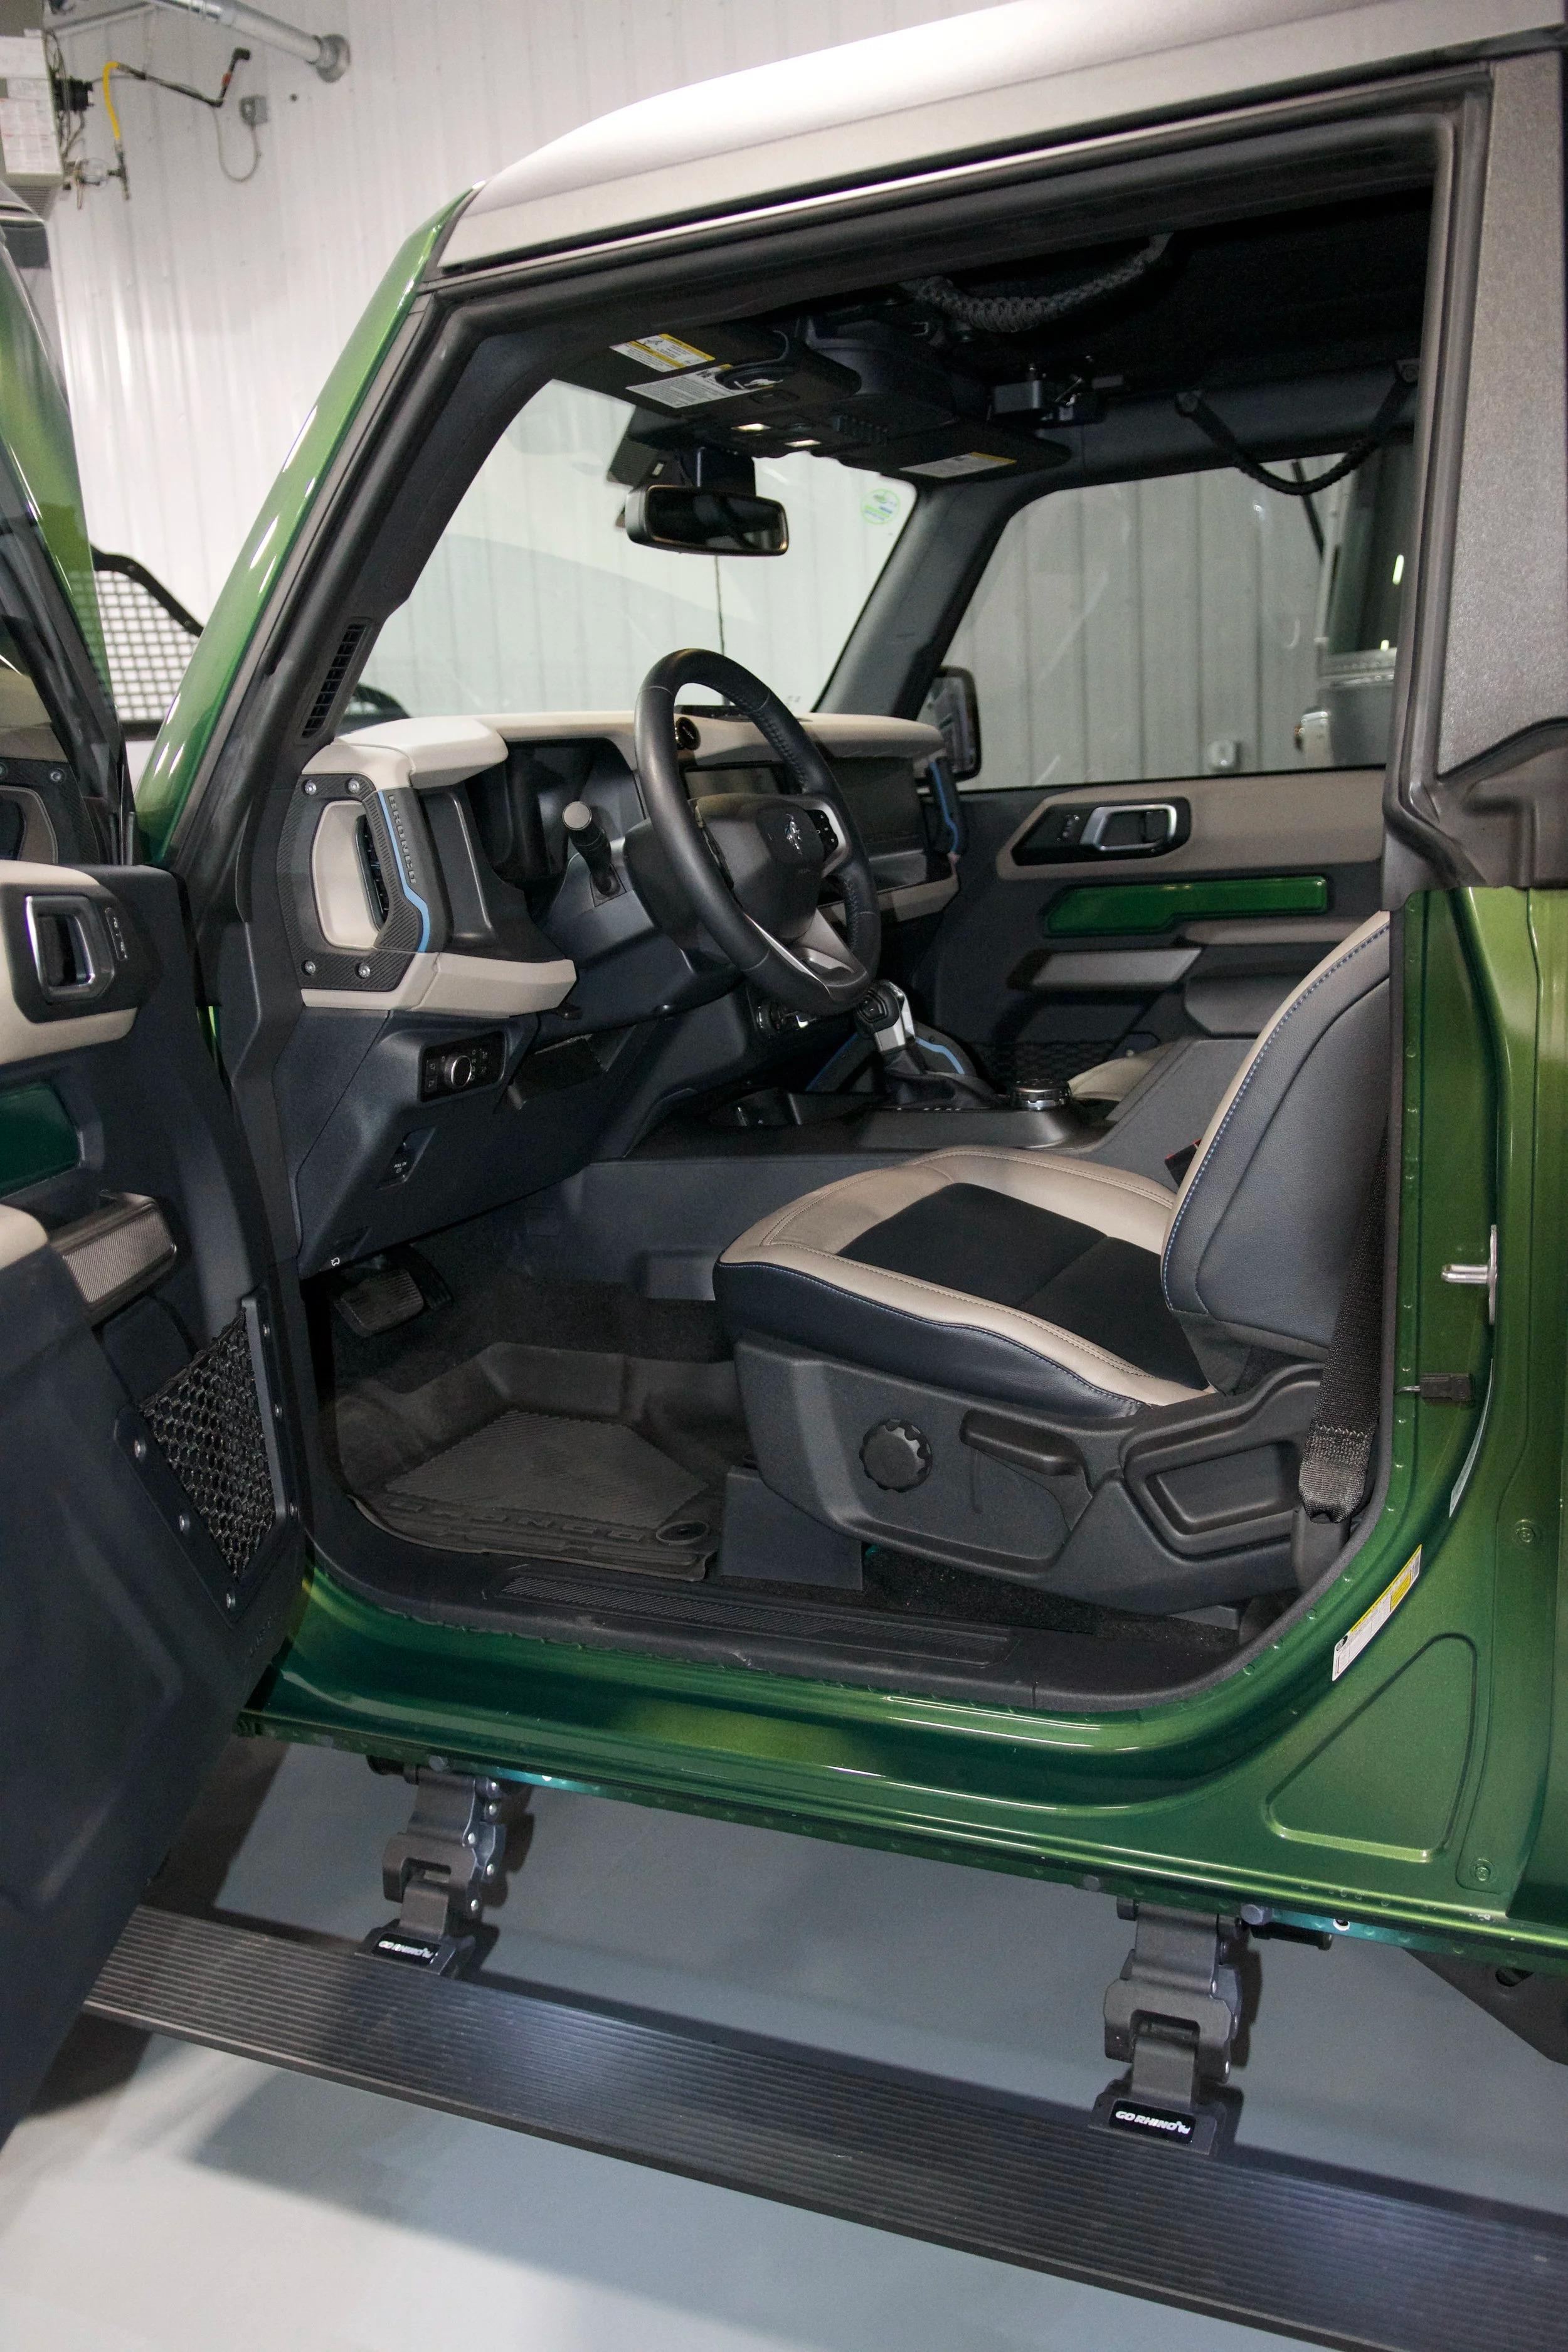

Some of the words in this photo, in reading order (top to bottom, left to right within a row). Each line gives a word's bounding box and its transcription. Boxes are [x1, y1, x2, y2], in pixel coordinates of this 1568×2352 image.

[388, 795, 416, 884] BRONCO
[1115, 2111, 1135, 2121] GO
[1134, 2114, 1177, 2131] RHINO
